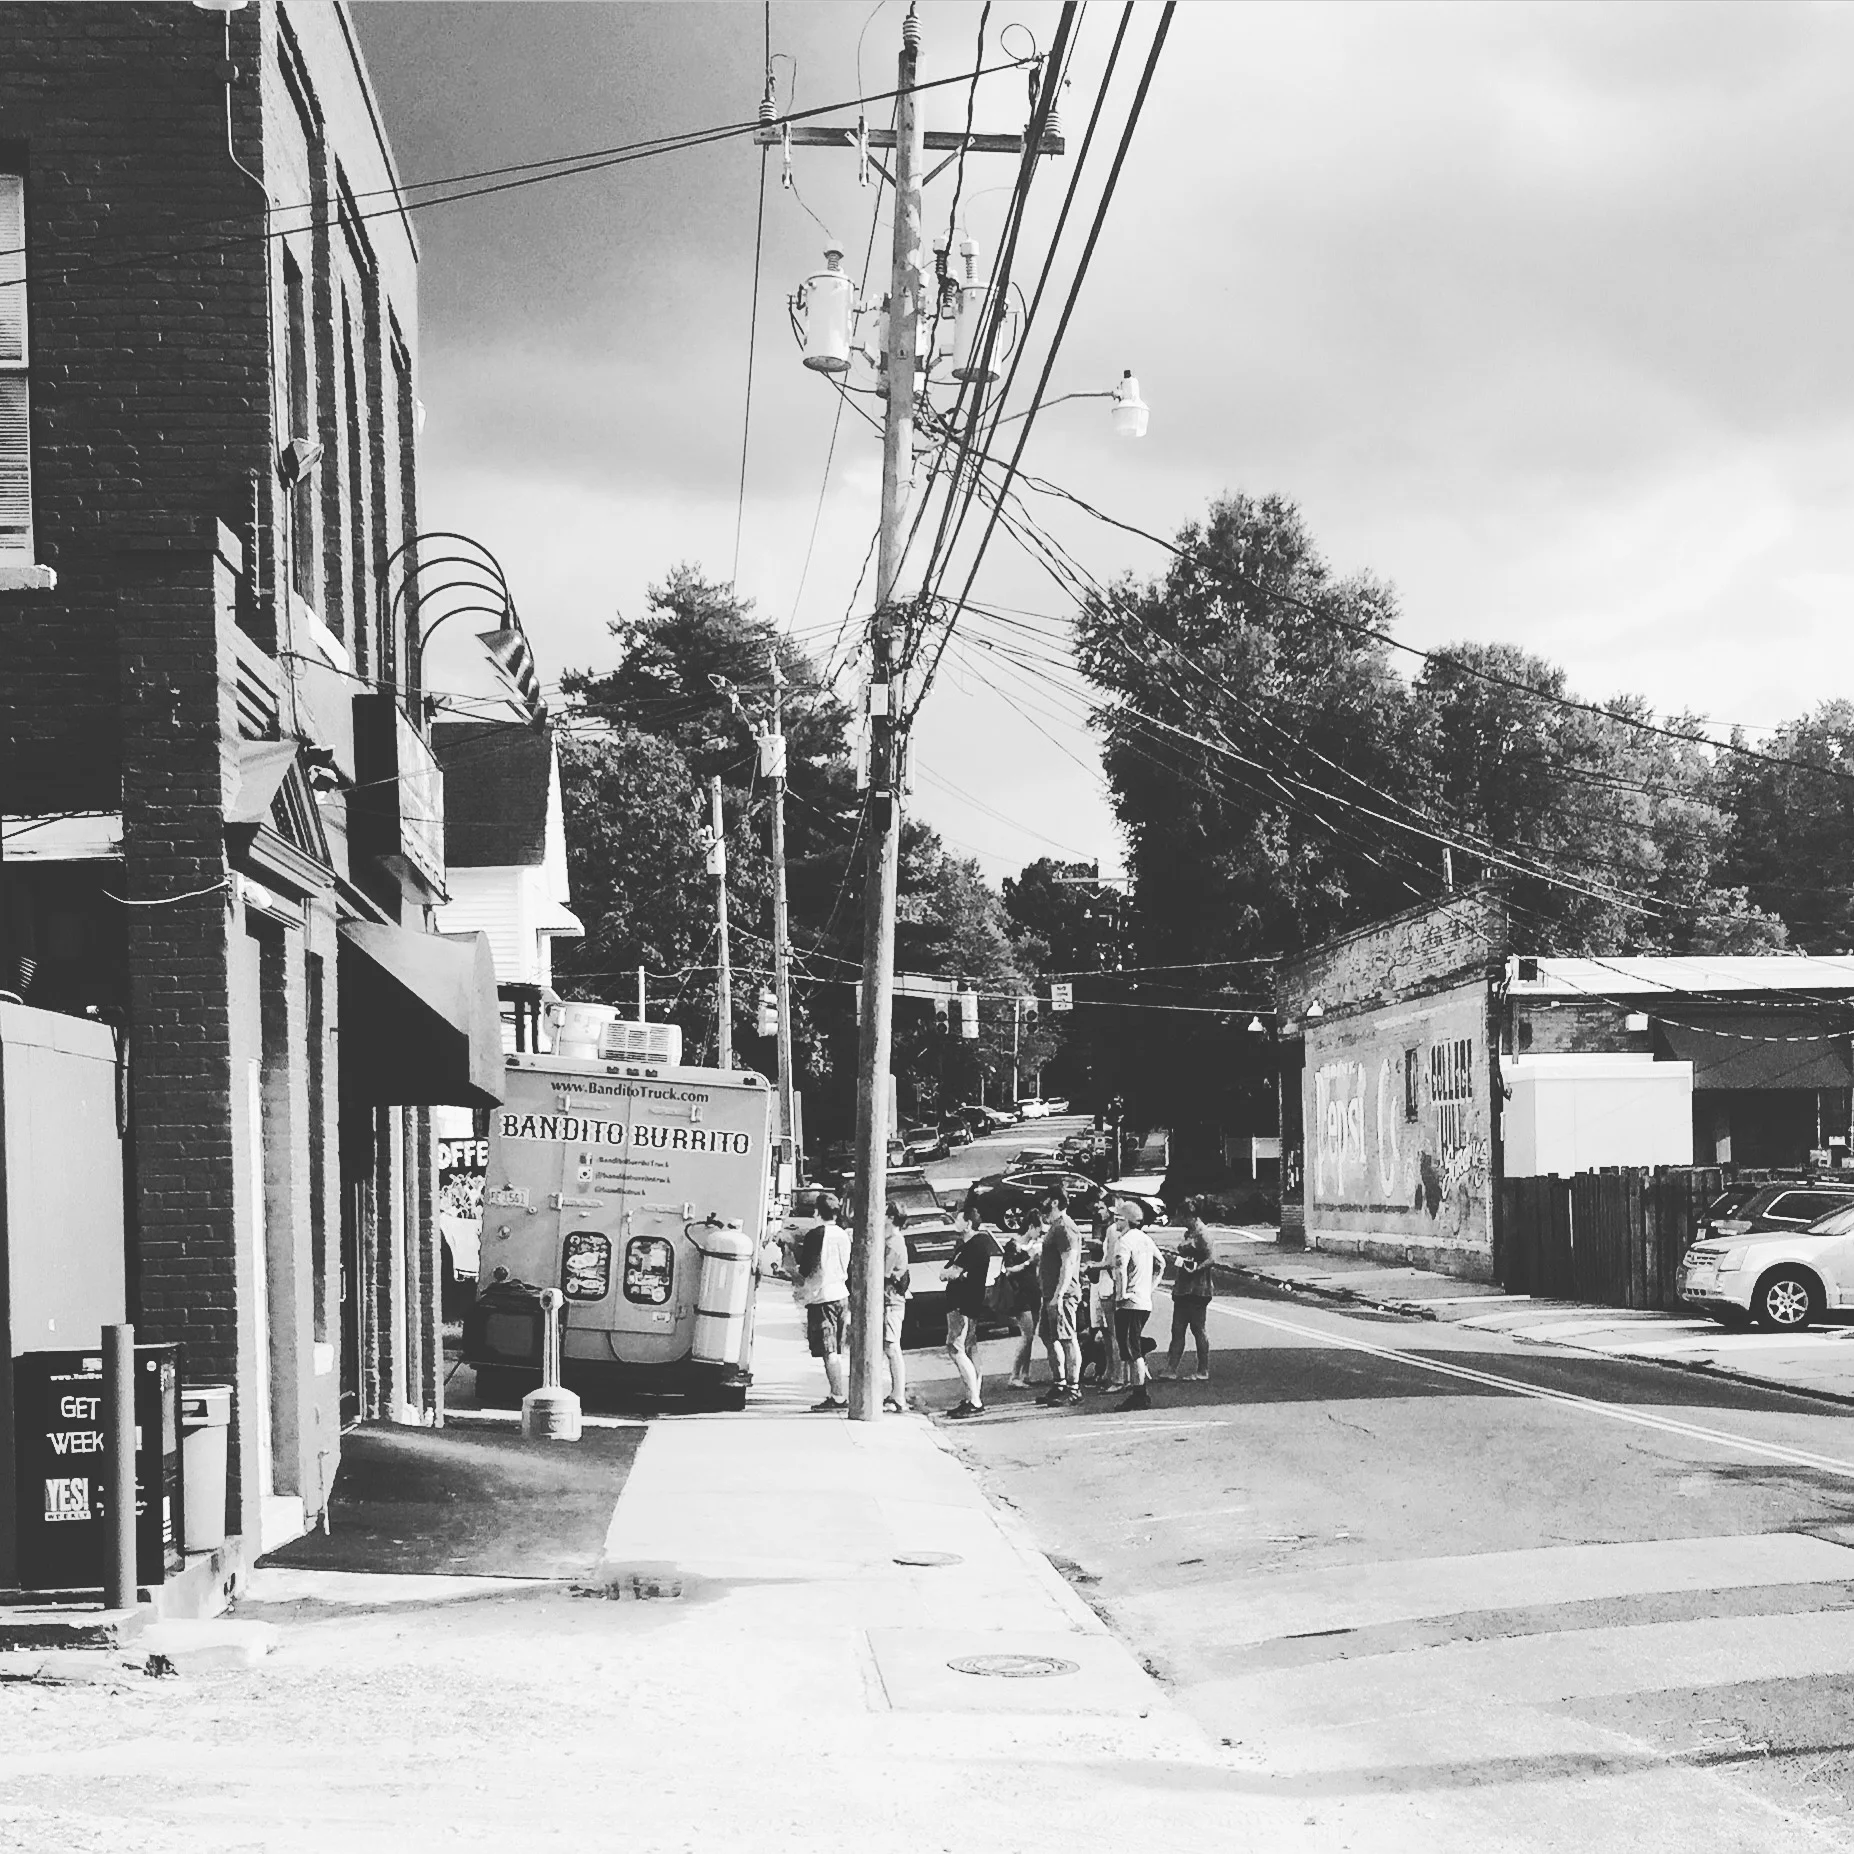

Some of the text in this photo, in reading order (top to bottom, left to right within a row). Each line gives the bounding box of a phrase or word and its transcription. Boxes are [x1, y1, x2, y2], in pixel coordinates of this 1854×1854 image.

[551, 1081, 709, 1103] www.BanditoTruck.com
[502, 1114, 750, 1154] BANDITO BURRITO
[60, 1396, 102, 1420] GET
[45, 1477, 90, 1512] YES!
